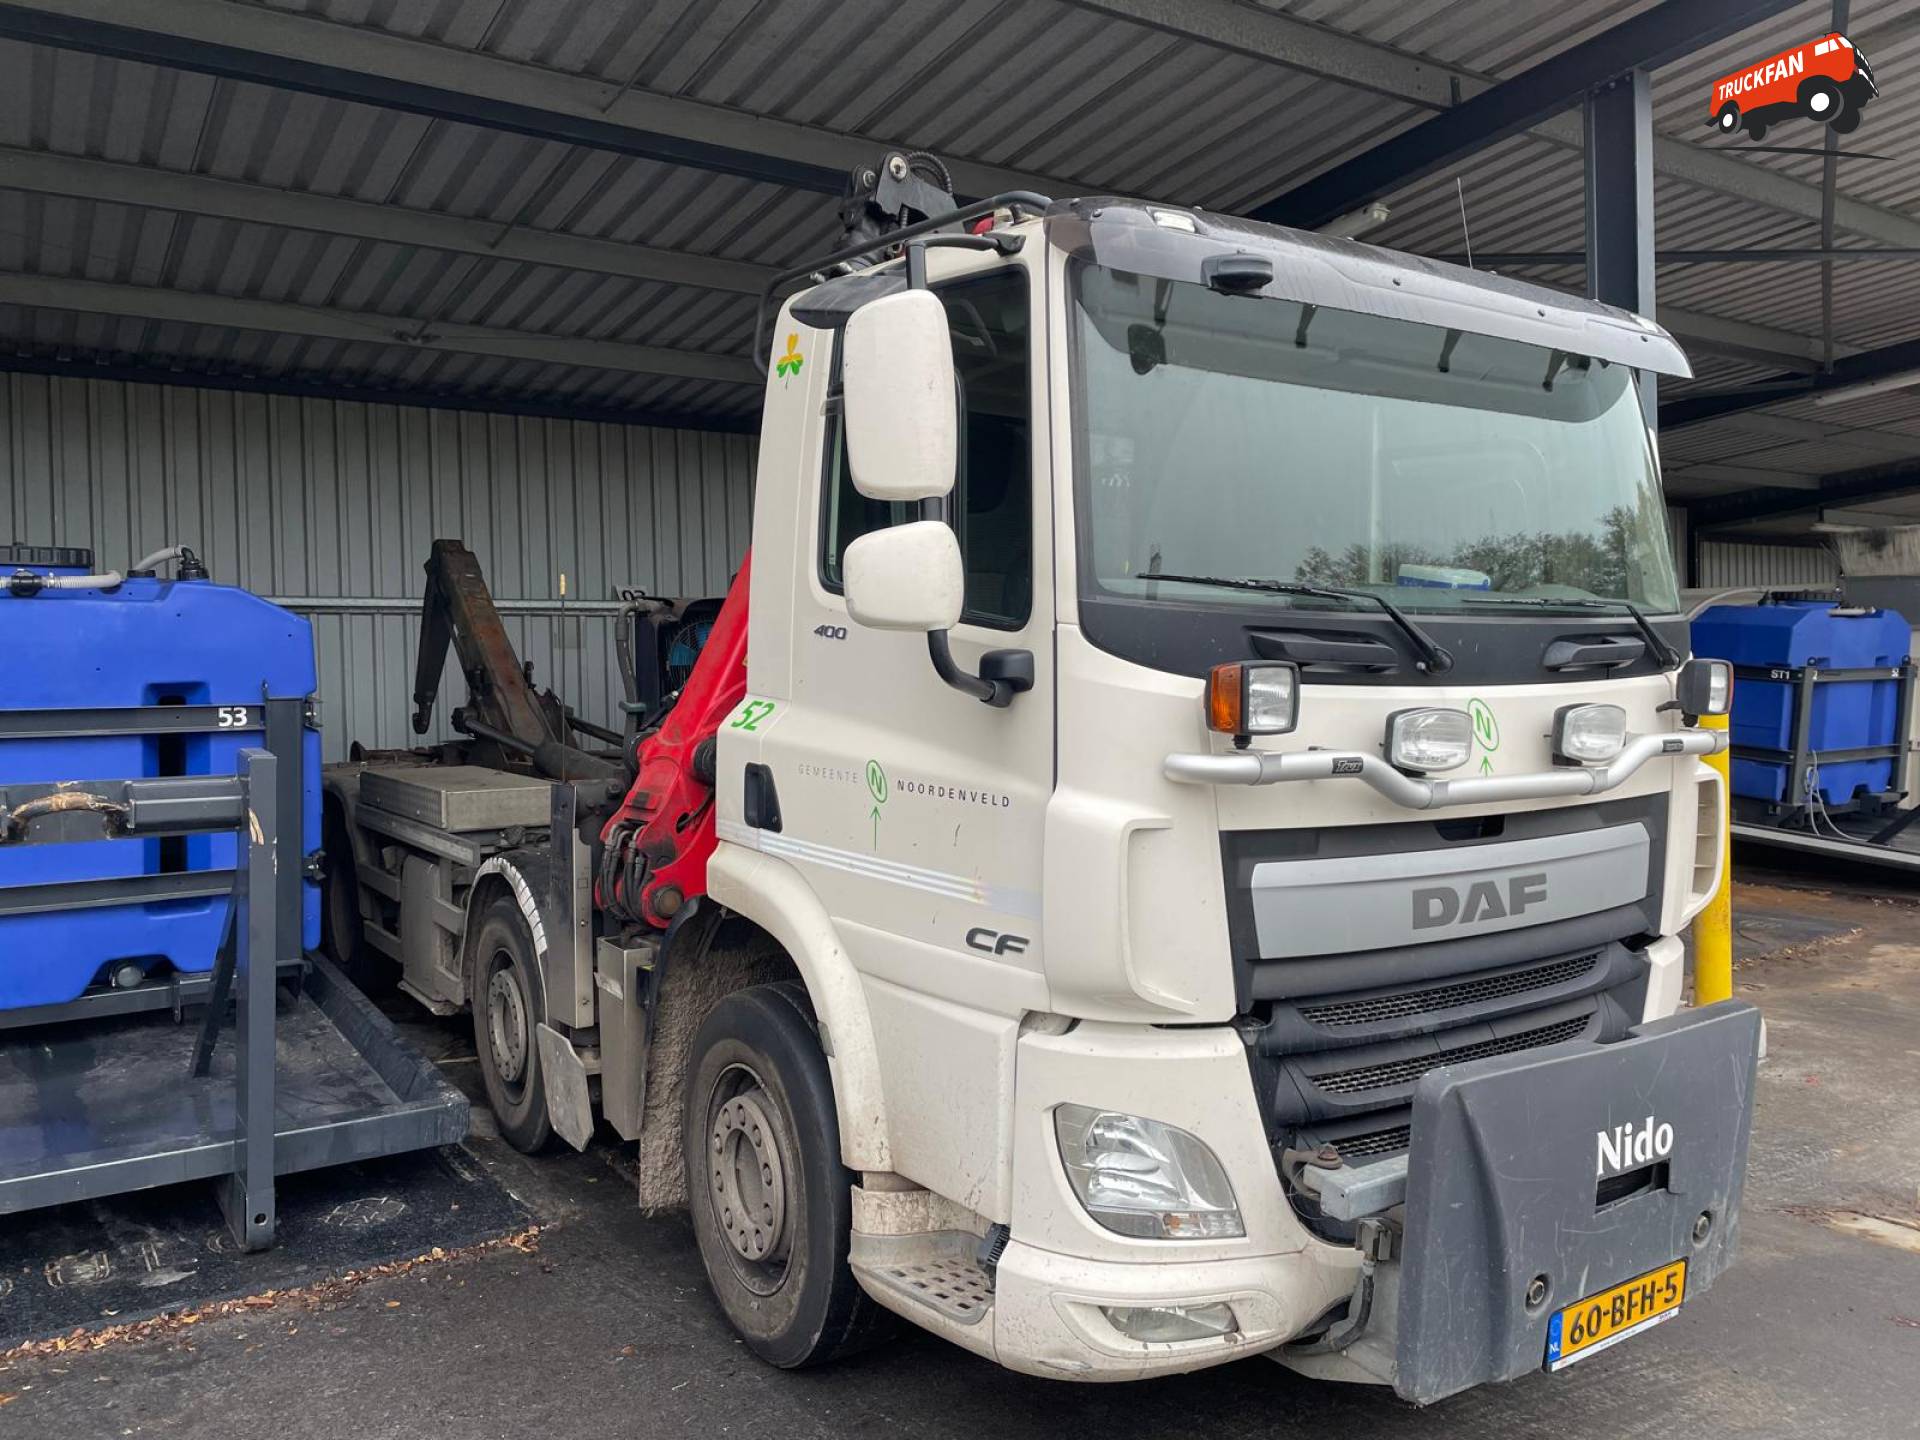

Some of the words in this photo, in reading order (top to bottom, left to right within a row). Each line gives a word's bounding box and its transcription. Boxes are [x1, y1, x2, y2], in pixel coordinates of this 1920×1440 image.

[813, 625, 847, 640] 400
[218, 707, 248, 727] 53
[731, 700, 776, 731] 52
[798, 763, 859, 784] GEMEENTE
[897, 779, 1010, 808] NOORDENVELD
[1412, 872, 1547, 930] DAF
[965, 927, 1030, 955] CF
[1596, 1115, 1674, 1176] Nido
[1570, 1271, 1678, 1345] 60-BFH-5
[1549, 1341, 1560, 1354] NL
